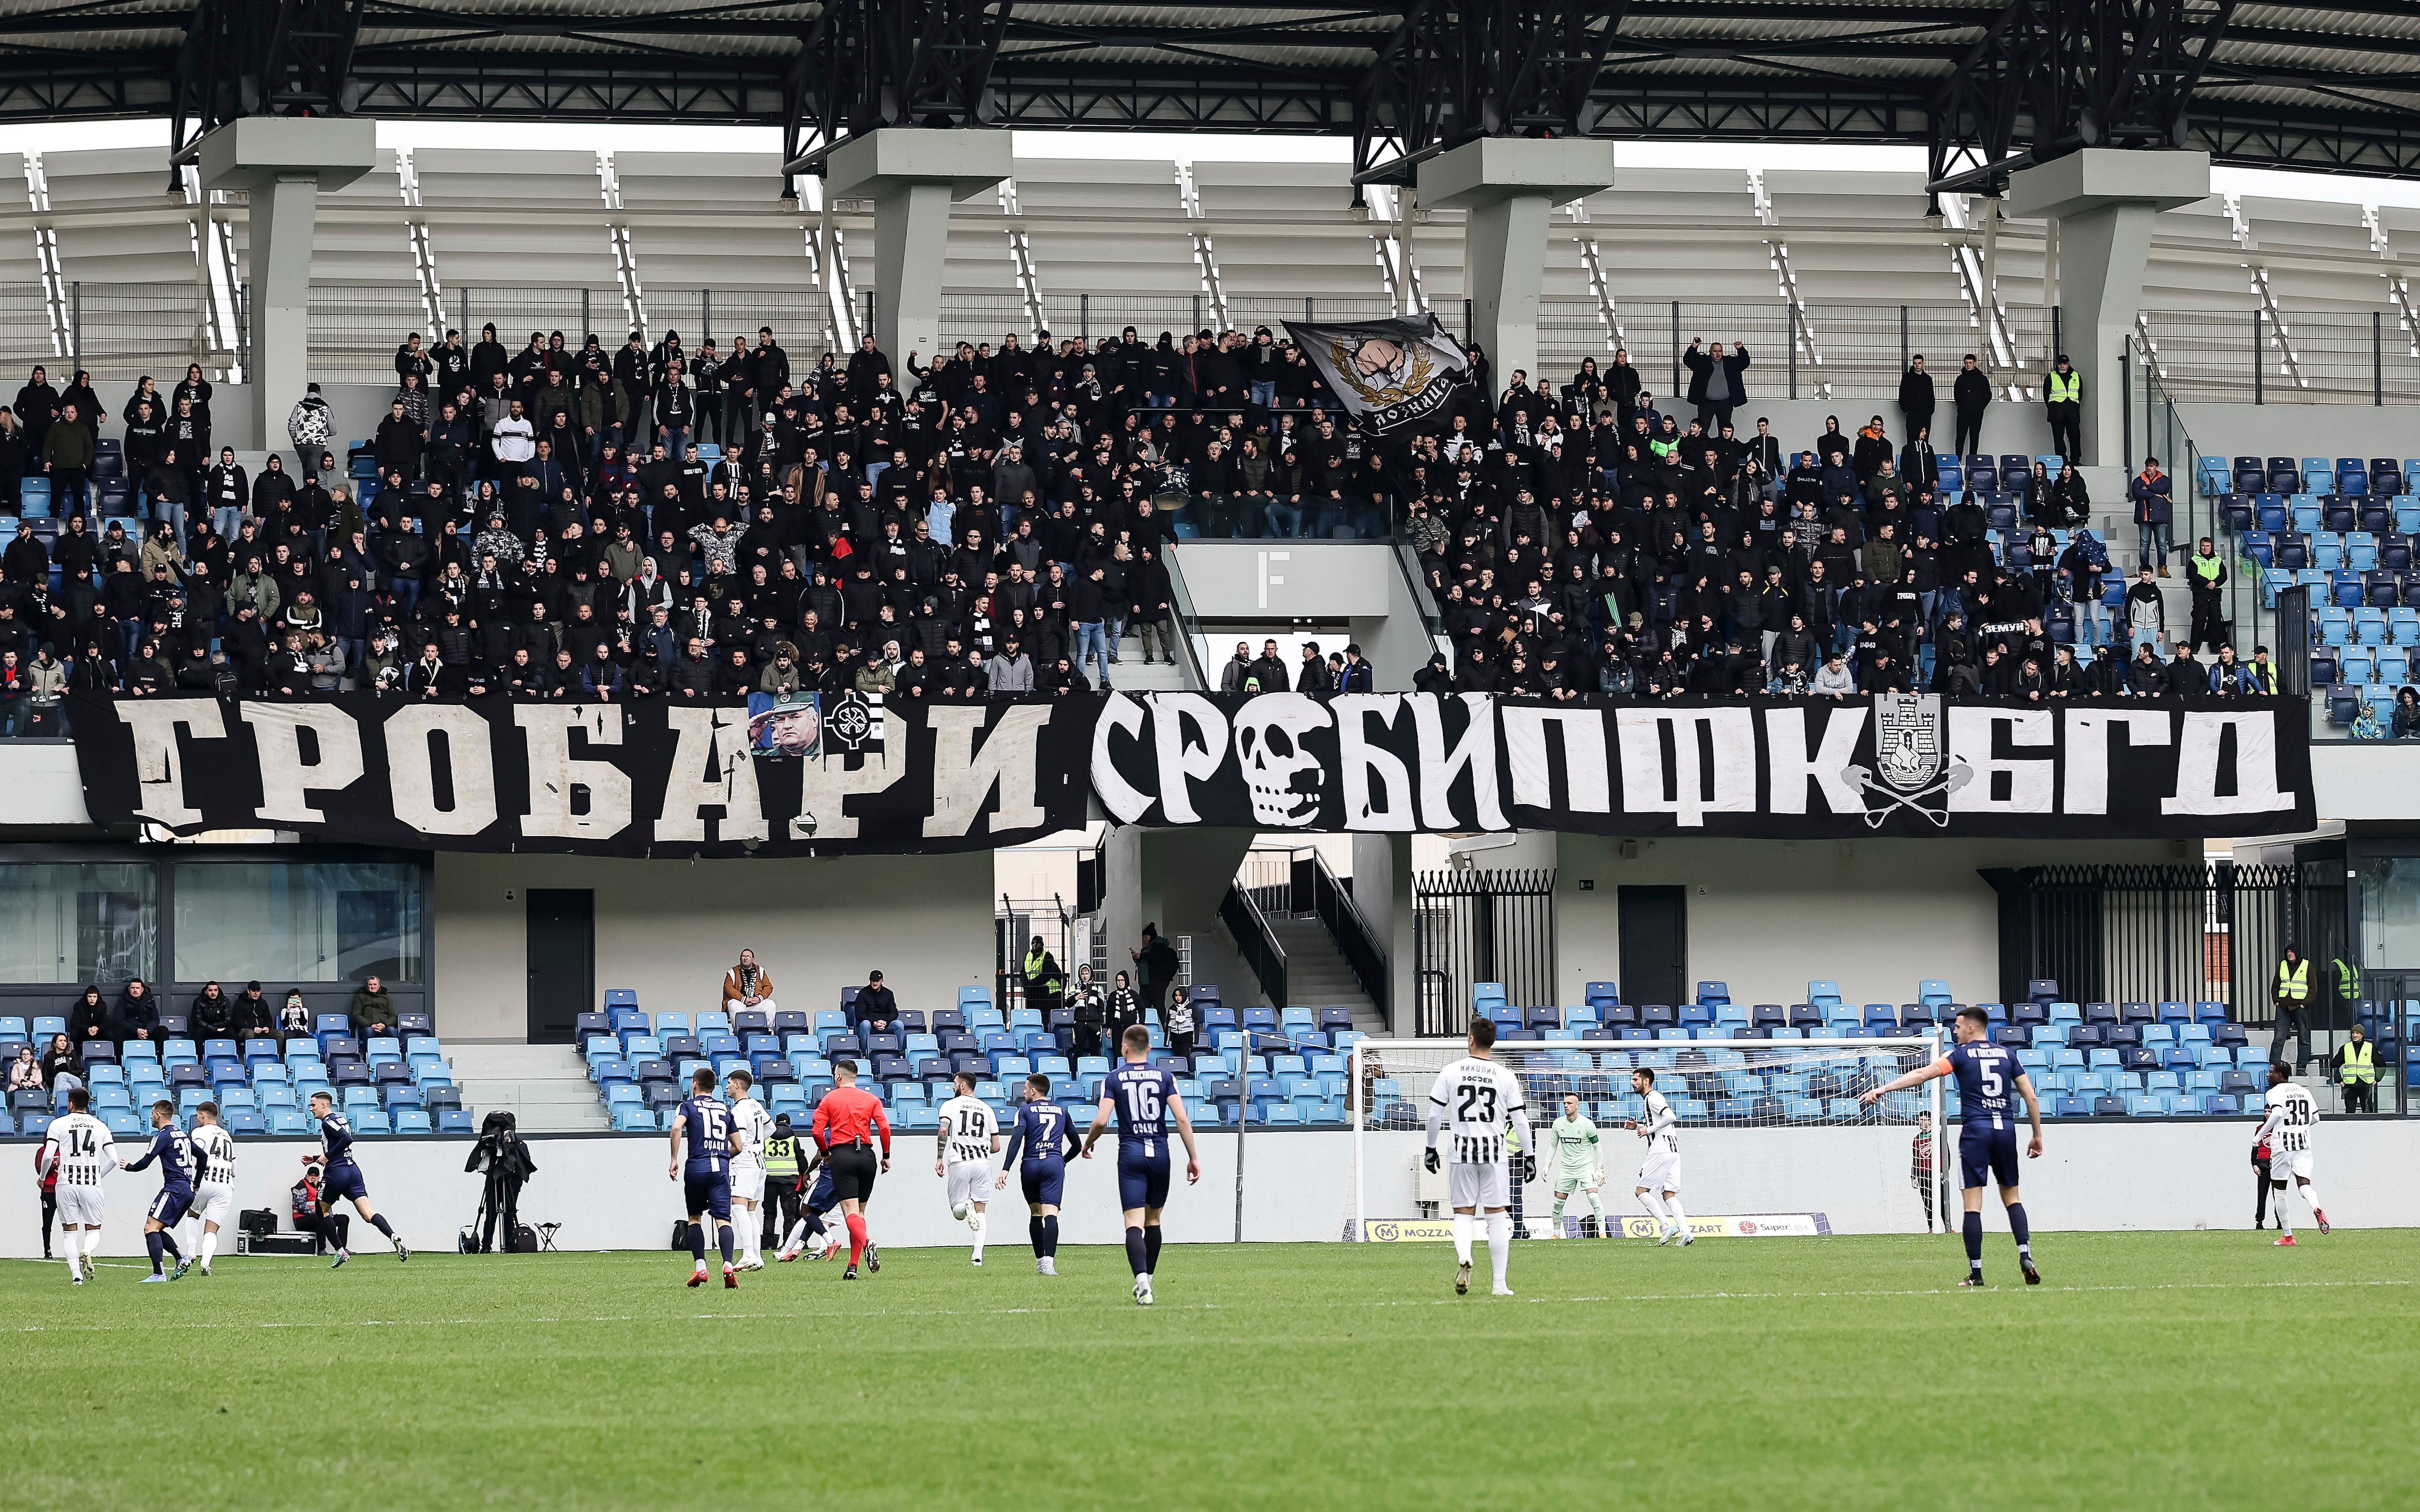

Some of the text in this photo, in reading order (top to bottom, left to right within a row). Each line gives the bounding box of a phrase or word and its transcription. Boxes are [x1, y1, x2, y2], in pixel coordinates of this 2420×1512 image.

[1258, 551, 1290, 609] F
[172, 612, 182, 628] PFC
[1984, 622, 2024, 633] ЗЕМУН
[113, 698, 1052, 841] ГРОБАРИ
[1948, 706, 2295, 815] БГД
[1979, 1059, 2003, 1097] 5
[1122, 1081, 1160, 1121] 16
[1457, 1085, 1496, 1123] 23
[2284, 1100, 2309, 1126] 39
[698, 1107, 727, 1140] 15
[958, 1110, 985, 1137] 19
[1039, 1113, 1056, 1141] 7
[69, 1129, 96, 1157] 14
[174, 1138, 193, 1167] 30
[210, 1136, 232, 1163] 40
[768, 1140, 789, 1157] 33
[1405, 1229, 1454, 1237] MOZZA
[1760, 1224, 1807, 1232] SuperLiga
